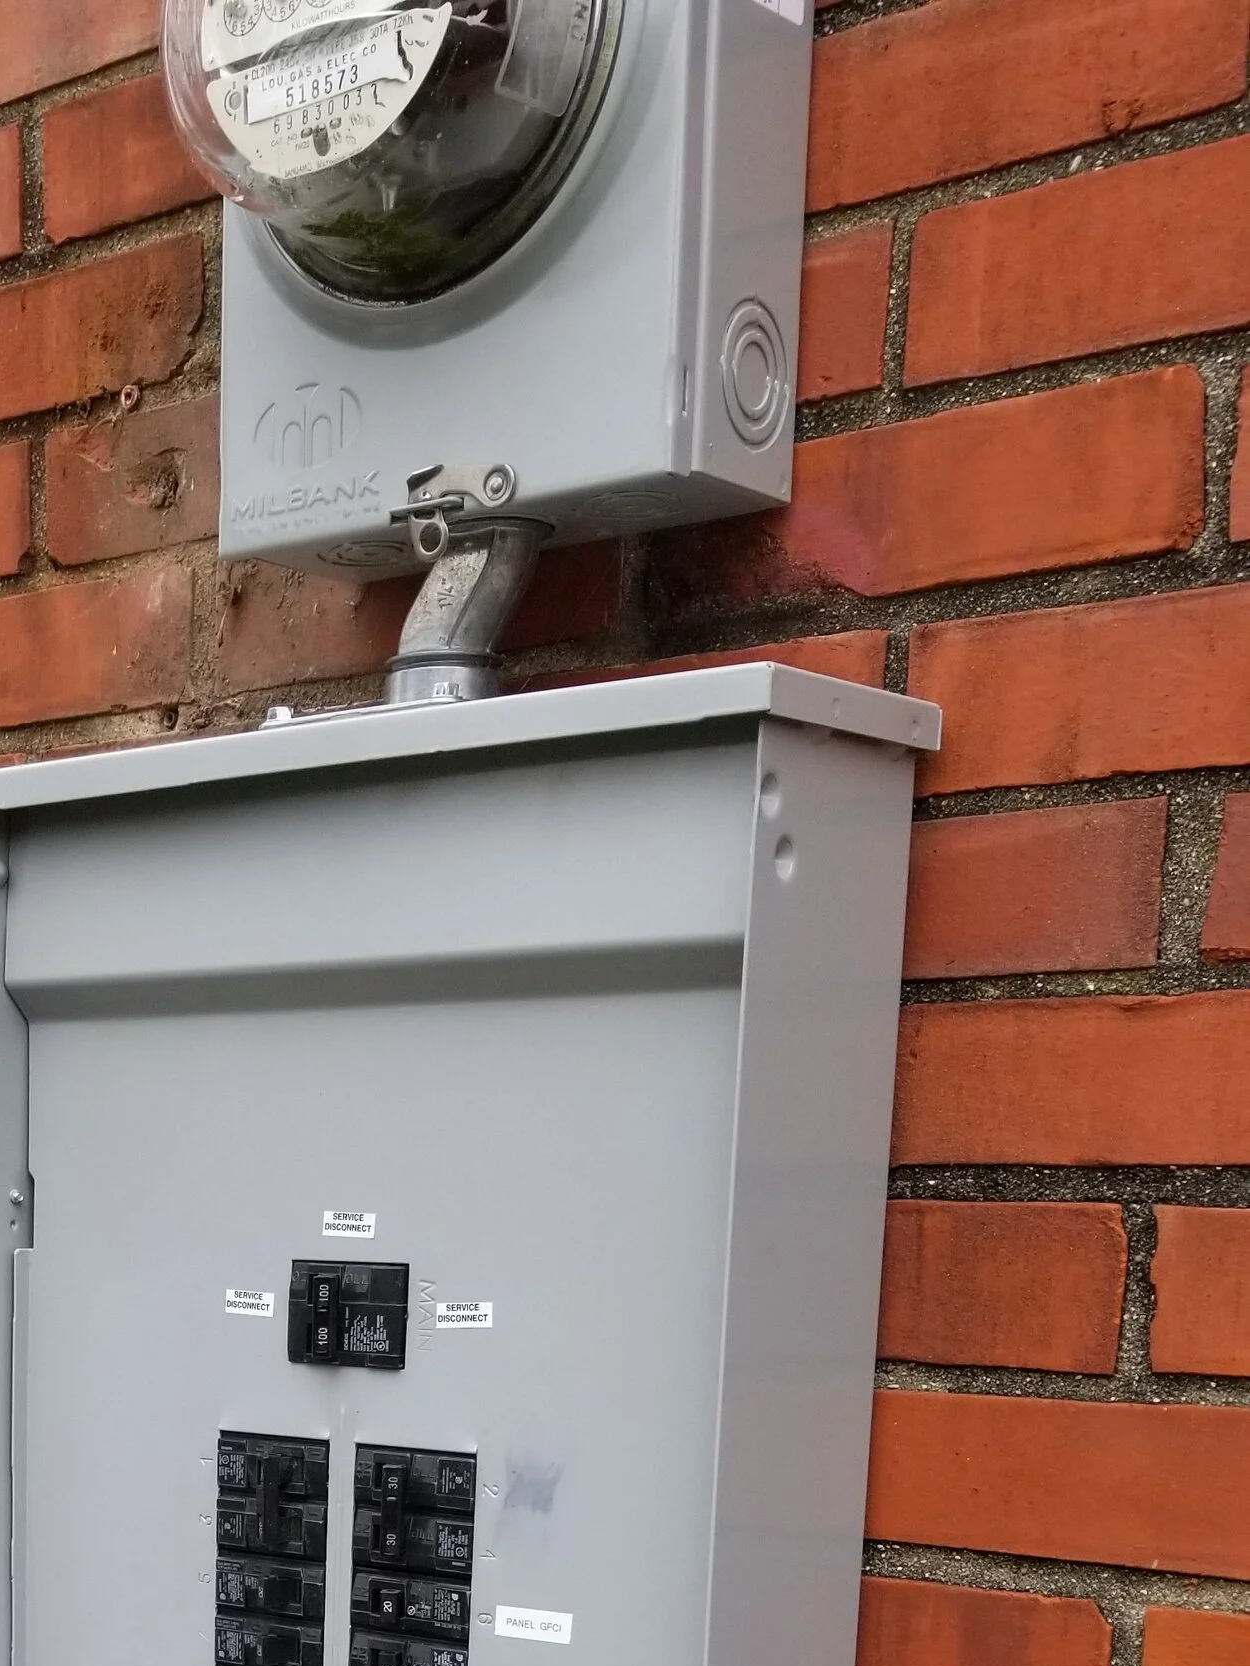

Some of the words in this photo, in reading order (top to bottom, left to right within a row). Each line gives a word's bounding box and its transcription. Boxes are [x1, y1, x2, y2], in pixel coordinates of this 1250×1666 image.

[291, 0, 356, 30] KILOWATTHOURS
[290, 67, 312, 82] GAS
[326, 51, 356, 69] ELEC
[362, 43, 377, 57] CO
[285, 64, 358, 108] 518573
[230, 469, 381, 523] MILBANK
[332, 1212, 365, 1222] SERVICE
[324, 1222, 372, 1233] DISCONNECT
[233, 1290, 264, 1302] SERVICE
[319, 1284, 329, 1302] 100
[226, 1299, 271, 1312] DISCONNECT
[446, 1302, 480, 1313] SERVICE
[417, 1279, 437, 1353] MAIN
[437, 1313, 489, 1323] DISCONNECT
[317, 1327, 328, 1346] 100
[388, 1476, 399, 1490] 30
[481, 1483, 500, 1499] 2
[386, 1533, 397, 1547] 30
[198, 1572, 212, 1585] 5
[383, 1600, 393, 1613] 20
[476, 1611, 494, 1625] 6
[505, 1616, 535, 1630] PANEL
[540, 1621, 562, 1633] GFCI
